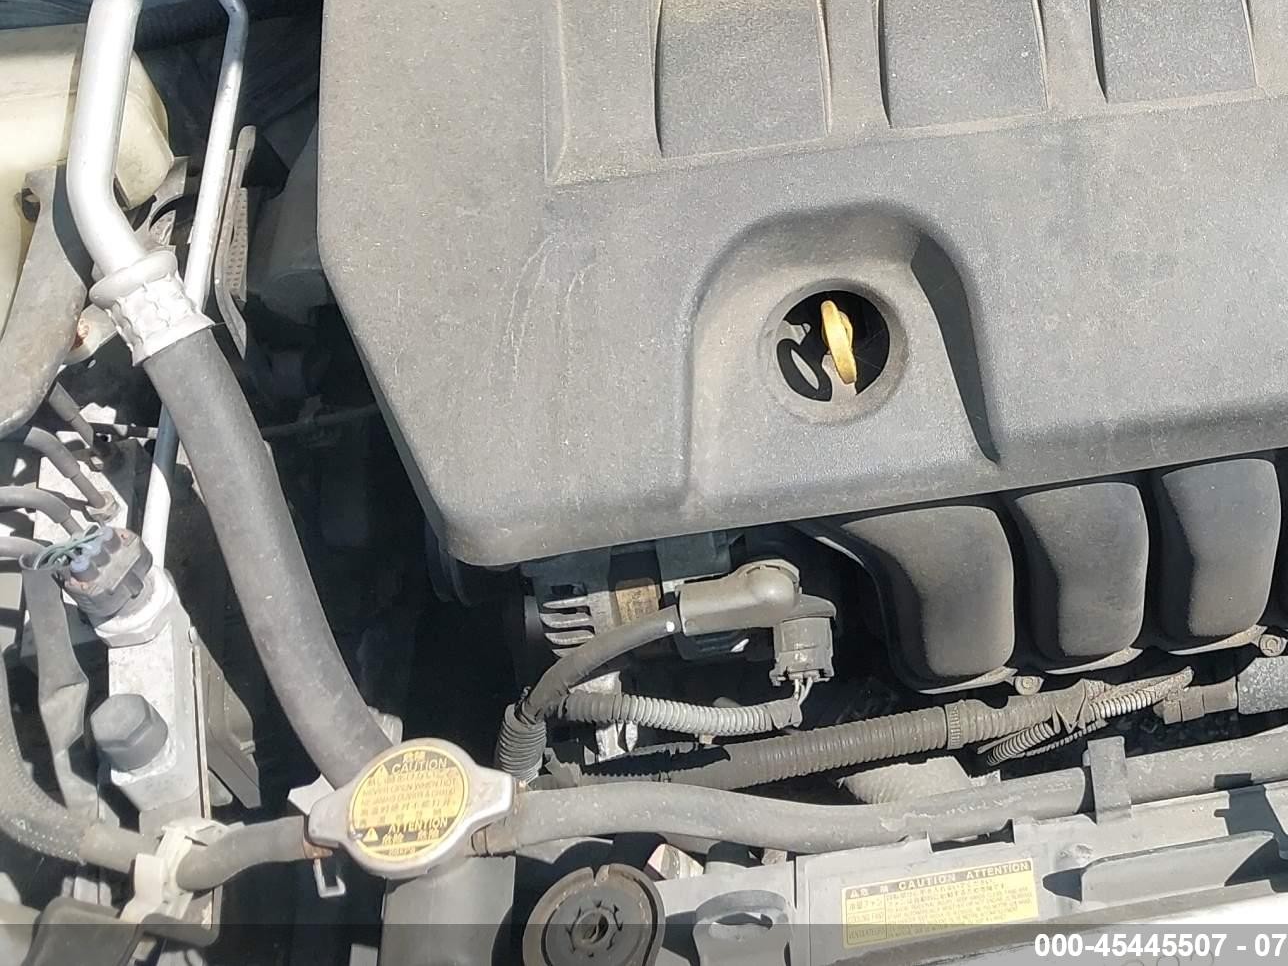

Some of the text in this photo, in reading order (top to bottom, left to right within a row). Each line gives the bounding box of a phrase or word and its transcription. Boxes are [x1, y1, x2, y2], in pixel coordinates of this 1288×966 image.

[391, 757, 448, 775] CAUTION
[387, 817, 449, 835] ATTENTION
[898, 861, 1030, 892] CAUTION ATTENTION
